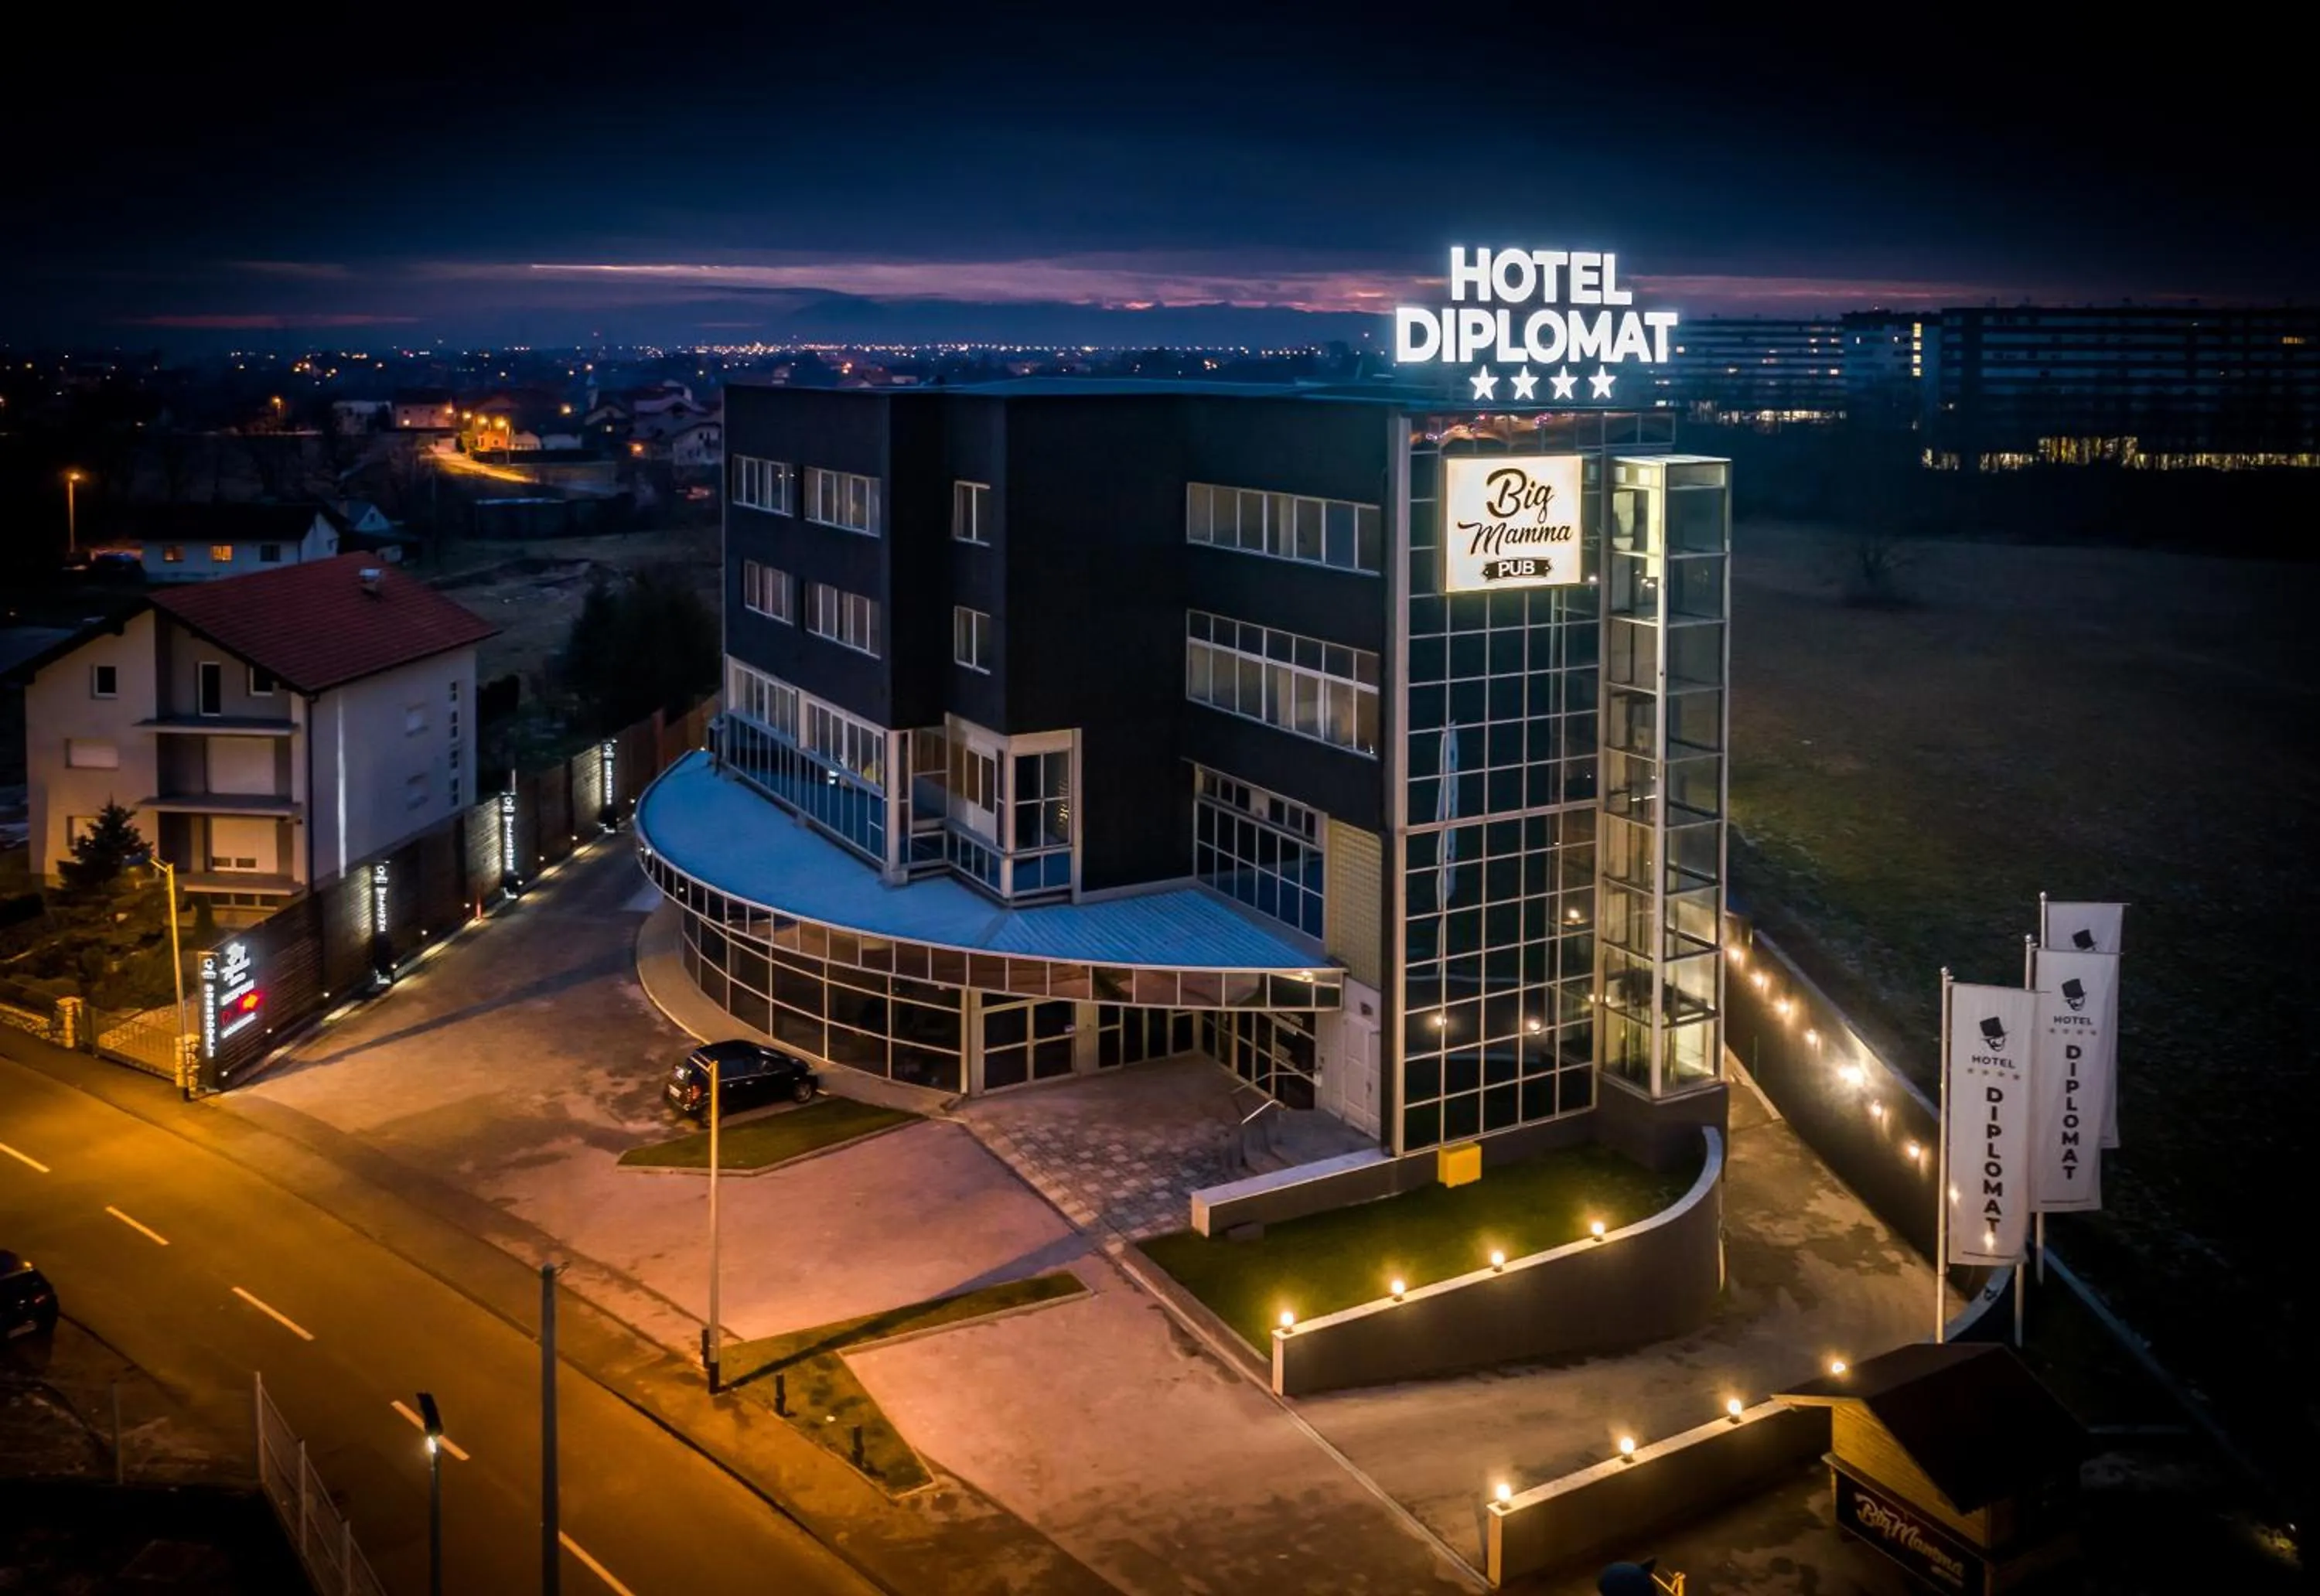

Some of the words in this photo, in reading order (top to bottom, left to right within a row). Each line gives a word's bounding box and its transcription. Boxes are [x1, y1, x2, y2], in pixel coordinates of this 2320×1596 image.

[1450, 247, 1633, 305] HOTEL
[1395, 307, 1678, 364] DIPLOMAT
[1486, 468, 1554, 523] Big
[1457, 521, 1572, 555] Mamma
[1498, 561, 1537, 577] PUB
[2052, 1015, 2093, 1026] HOTEL
[1971, 1055, 2016, 1069] HOTEL
[2062, 1045, 2082, 1180] DIPLOMAT
[1983, 1086, 2004, 1233] DIPLOMAT
